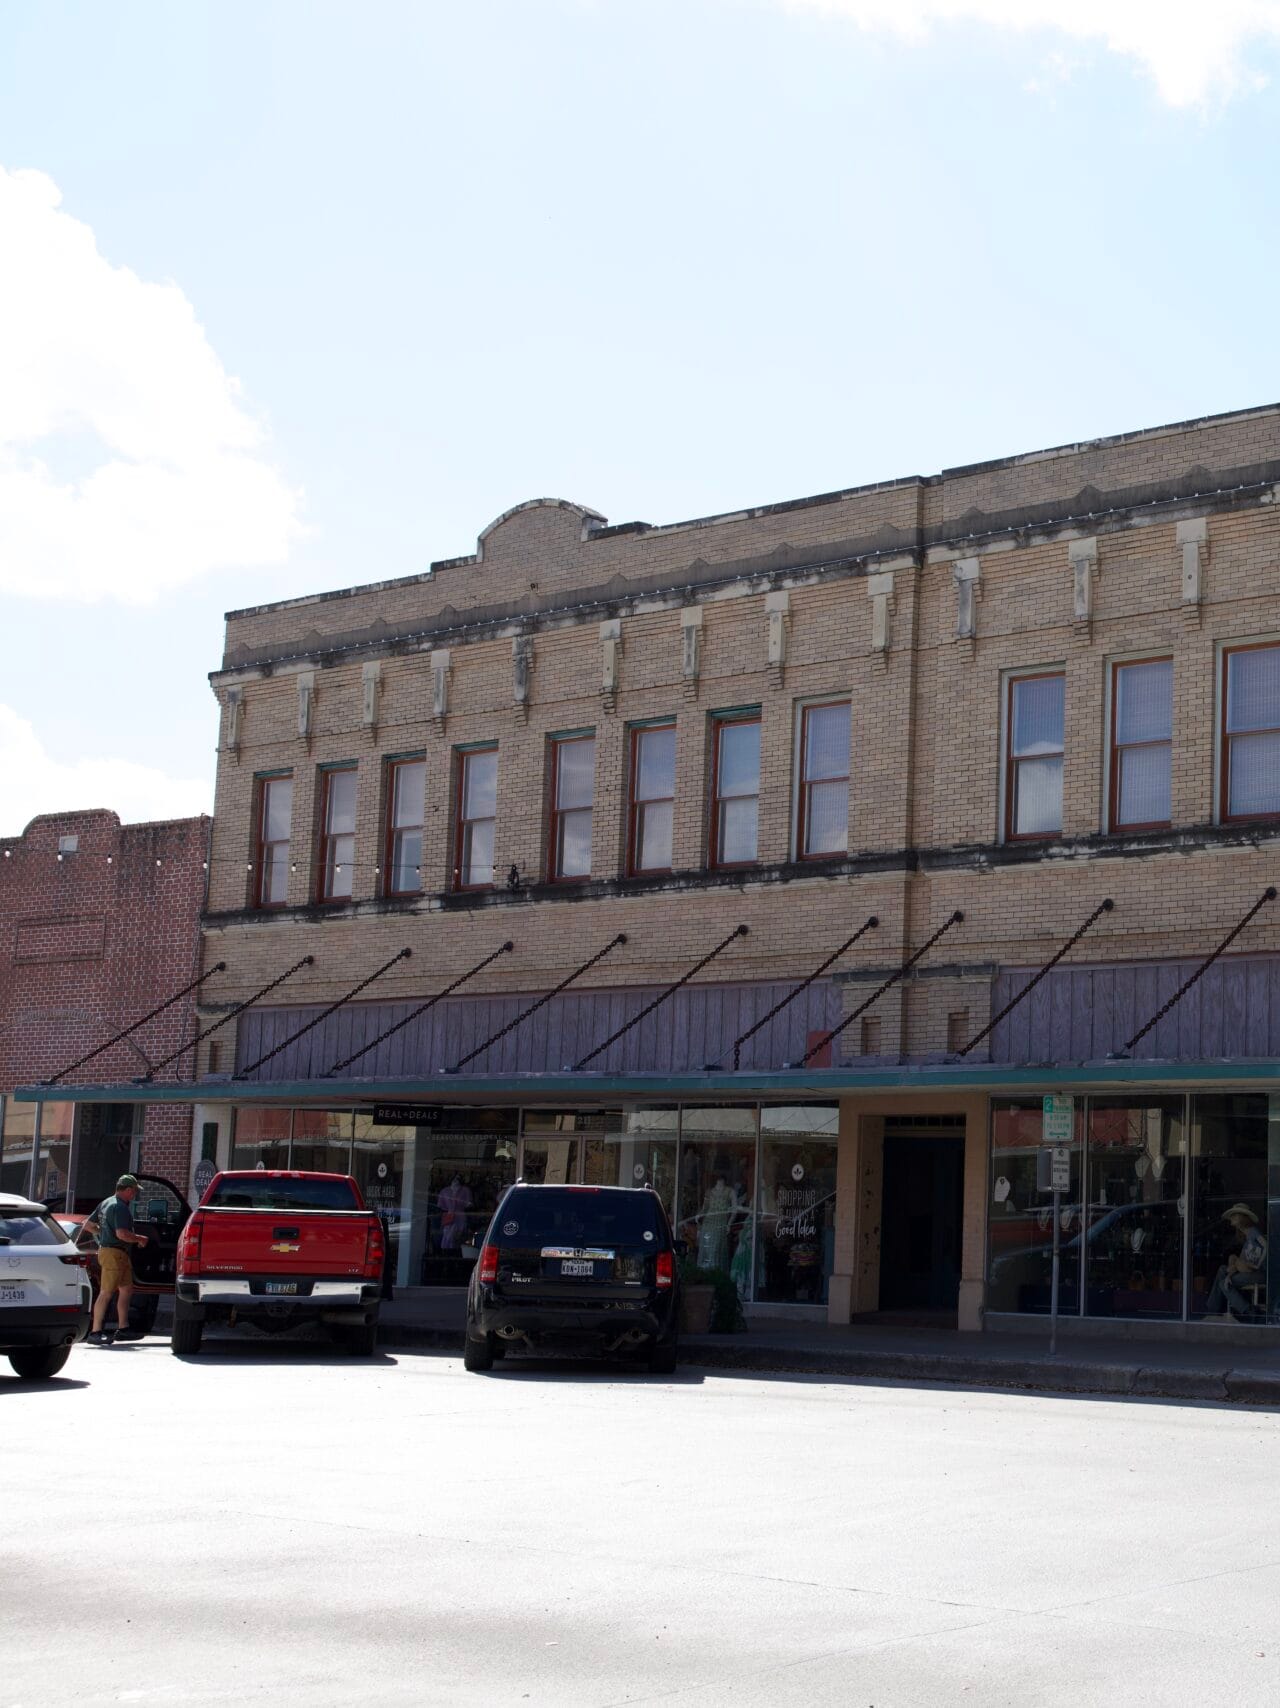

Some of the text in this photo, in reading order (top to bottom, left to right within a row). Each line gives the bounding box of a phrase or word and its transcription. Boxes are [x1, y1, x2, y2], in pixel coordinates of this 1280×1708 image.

[378, 1109, 438, 1120] REAL DEALS
[777, 1189, 815, 1206] SHOPPING
